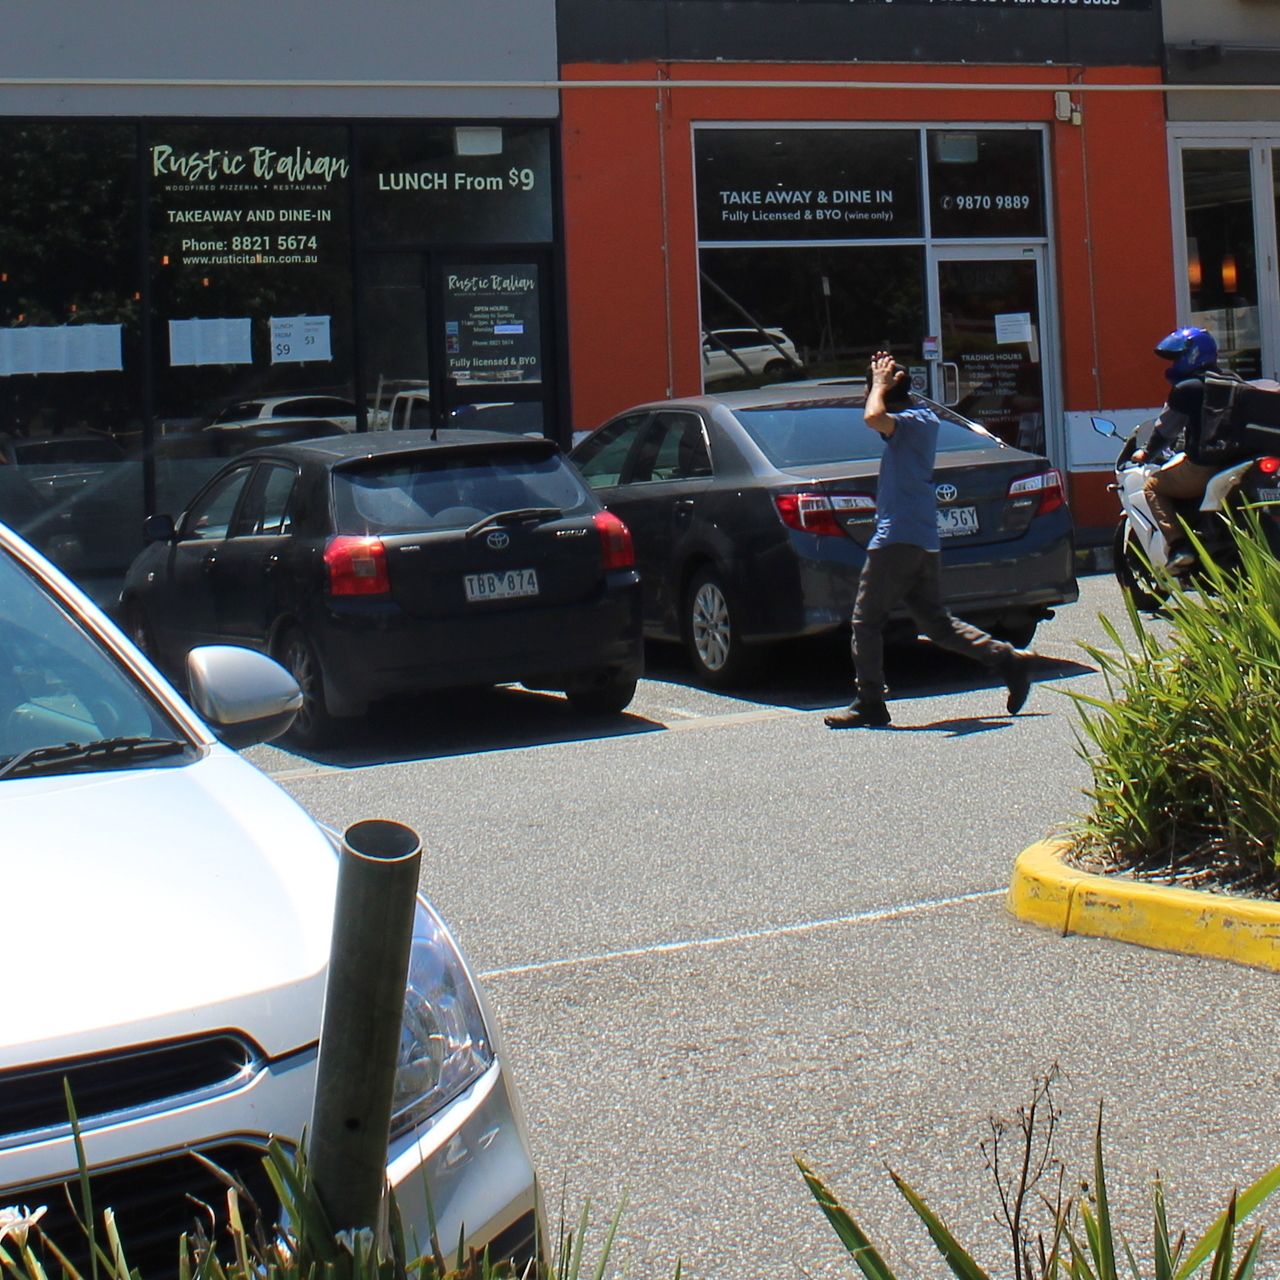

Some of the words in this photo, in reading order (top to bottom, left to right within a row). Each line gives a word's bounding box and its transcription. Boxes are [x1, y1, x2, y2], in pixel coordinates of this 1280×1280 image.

[150, 144, 246, 181] Rustic
[249, 146, 350, 182] Italian
[378, 173, 447, 190] LUNCH
[454, 173, 503, 190] From
[508, 167, 535, 191] $9
[719, 191, 762, 205] TAKE
[765, 190, 813, 204] AWAY
[817, 190, 828, 203] &
[833, 190, 871, 203] DINE
[875, 190, 893, 203] IN
[956, 195, 991, 210] 9870
[995, 195, 1030, 209] 9889
[167, 210, 243, 222] TAKEAWAY
[246, 210, 275, 222] AND
[279, 209, 332, 222] DINE-IN
[722, 210, 749, 223] Fully
[752, 210, 801, 221] Licensed
[804, 210, 813, 220] &
[816, 209, 842, 220] BYO
[844, 211, 869, 222] (wine
[871, 211, 894, 222] only)
[182, 238, 228, 251] Phone:
[232, 236, 270, 250] 8821
[277, 236, 318, 250] 5674
[448, 275, 490, 291] Rustic
[490, 275, 536, 291] Italian
[276, 343, 290, 356] $9
[961, 353, 995, 361] TRADING
[449, 358, 471, 368] Fully
[473, 357, 509, 367] licensed
[510, 357, 517, 366] &
[518, 356, 537, 365] BYO
[950, 508, 976, 528] 5GY
[466, 575, 497, 596] TBB
[507, 572, 536, 591] 874
